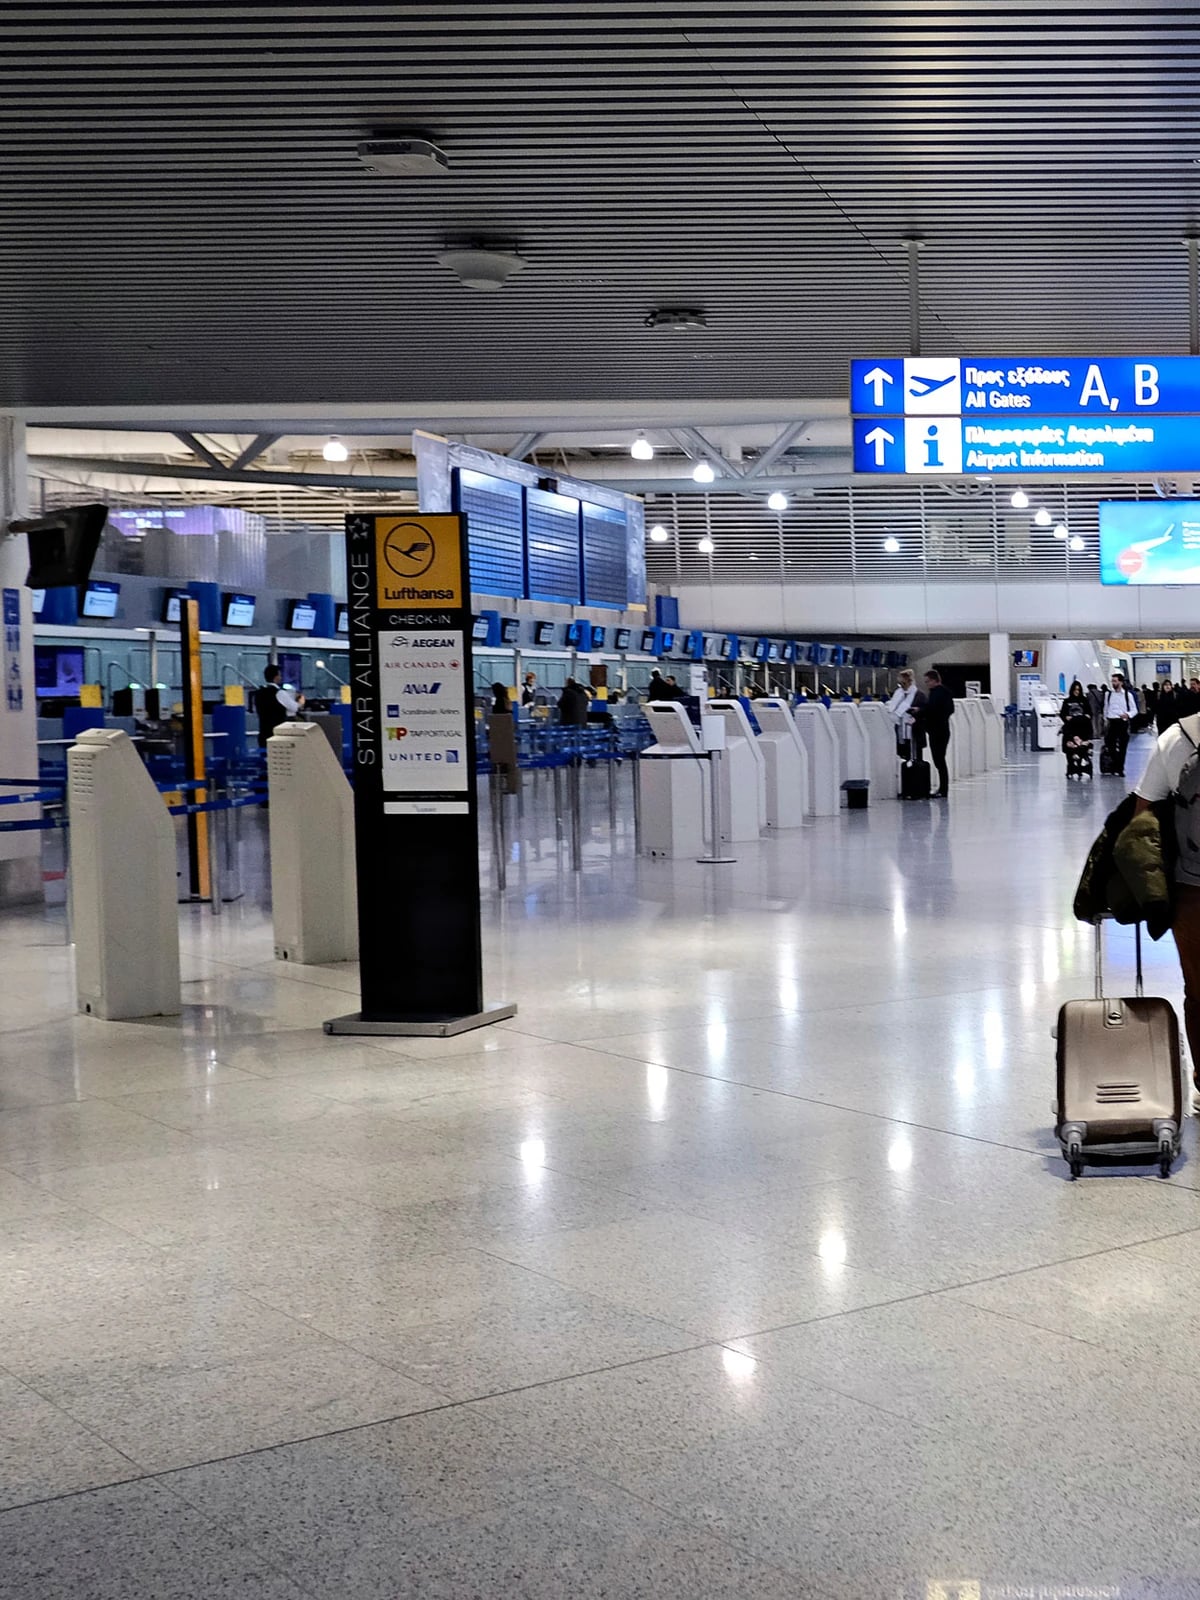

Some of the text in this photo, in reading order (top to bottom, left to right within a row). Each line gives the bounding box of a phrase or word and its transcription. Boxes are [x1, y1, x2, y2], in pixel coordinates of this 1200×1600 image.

[965, 366, 1005, 387] Προς
[1134, 363, 1160, 406] B
[965, 390, 1031, 408] All Gates
[966, 449, 1105, 470] Airport Information
[384, 587, 455, 600] Lufthansa
[388, 614, 452, 625] CHECK-IN
[411, 638, 456, 648] AEGEAN
[1135, 641, 1164, 650] Caring
[1168, 641, 1180, 649] for
[351, 552, 376, 766] STAR ALLIANCE
[384, 661, 447, 669] AIR CANADA
[402, 683, 431, 695] ANA
[388, 752, 443, 761] UNITED
